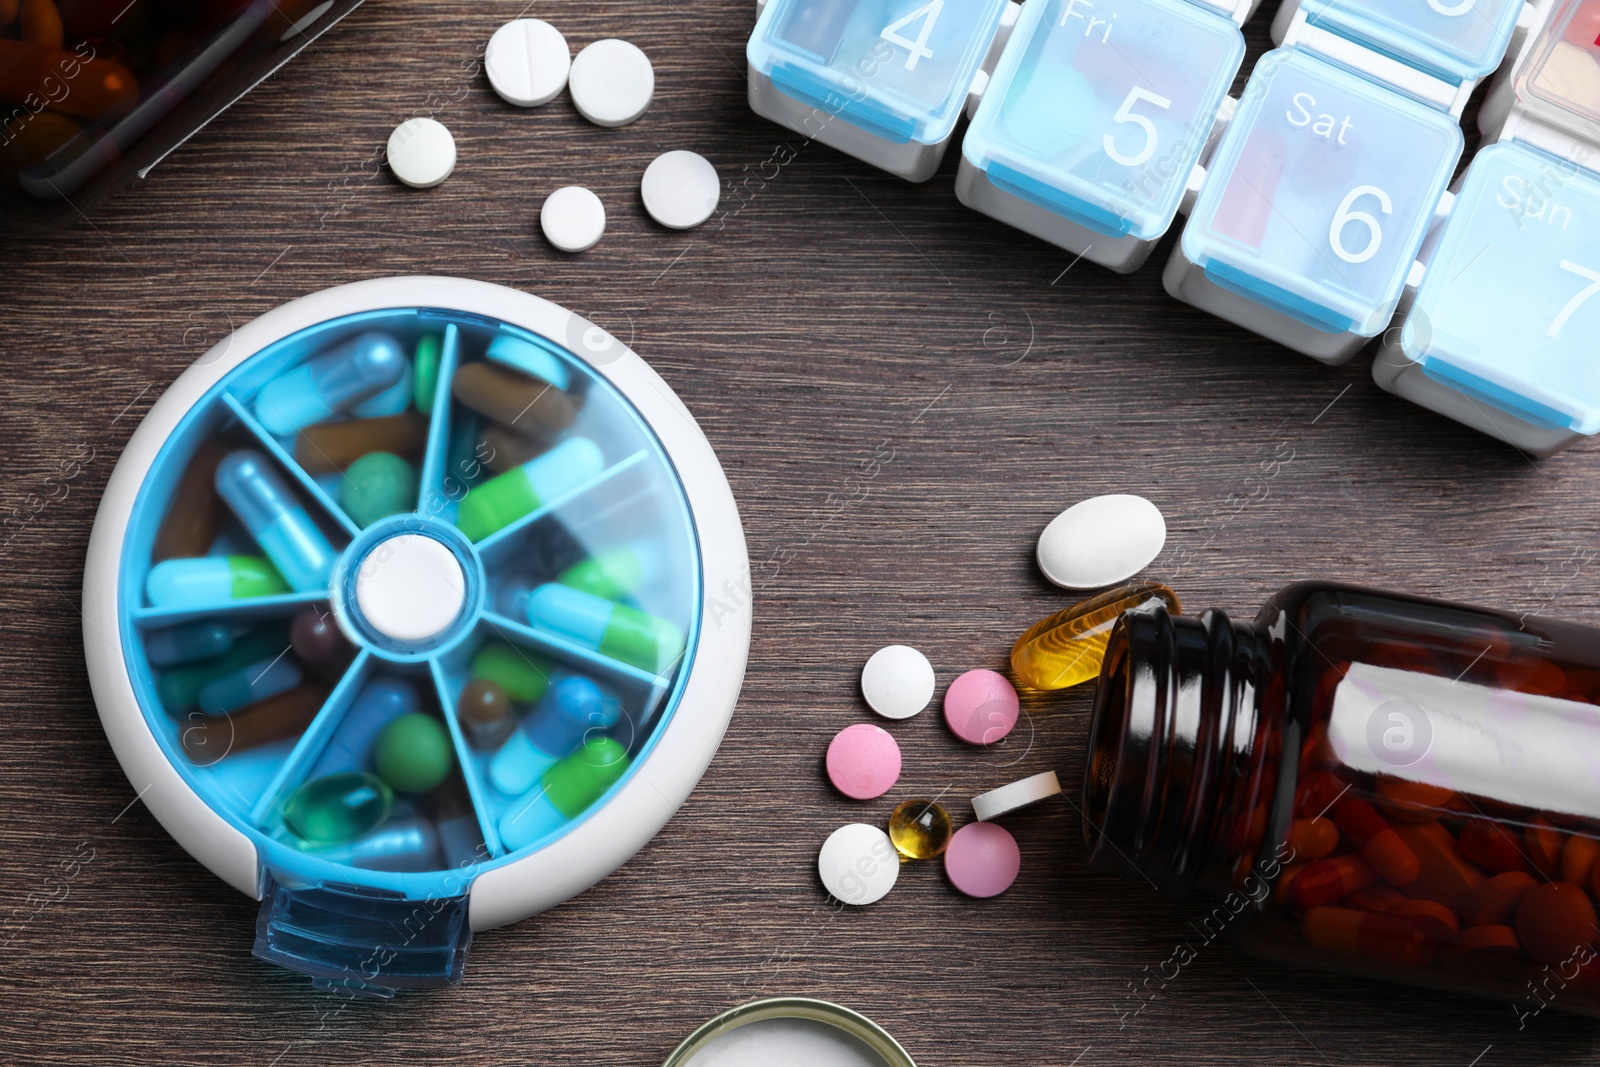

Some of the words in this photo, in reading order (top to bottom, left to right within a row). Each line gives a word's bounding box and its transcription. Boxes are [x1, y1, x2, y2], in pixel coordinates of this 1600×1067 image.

[879, 0, 945, 72] 4
[1058, 0, 1118, 44] Fri
[1102, 85, 1172, 167] 5
[1285, 92, 1354, 146] Sat
[1328, 185, 1393, 264] 6
[1496, 174, 1572, 230] Sun
[1545, 258, 1600, 339] 7
